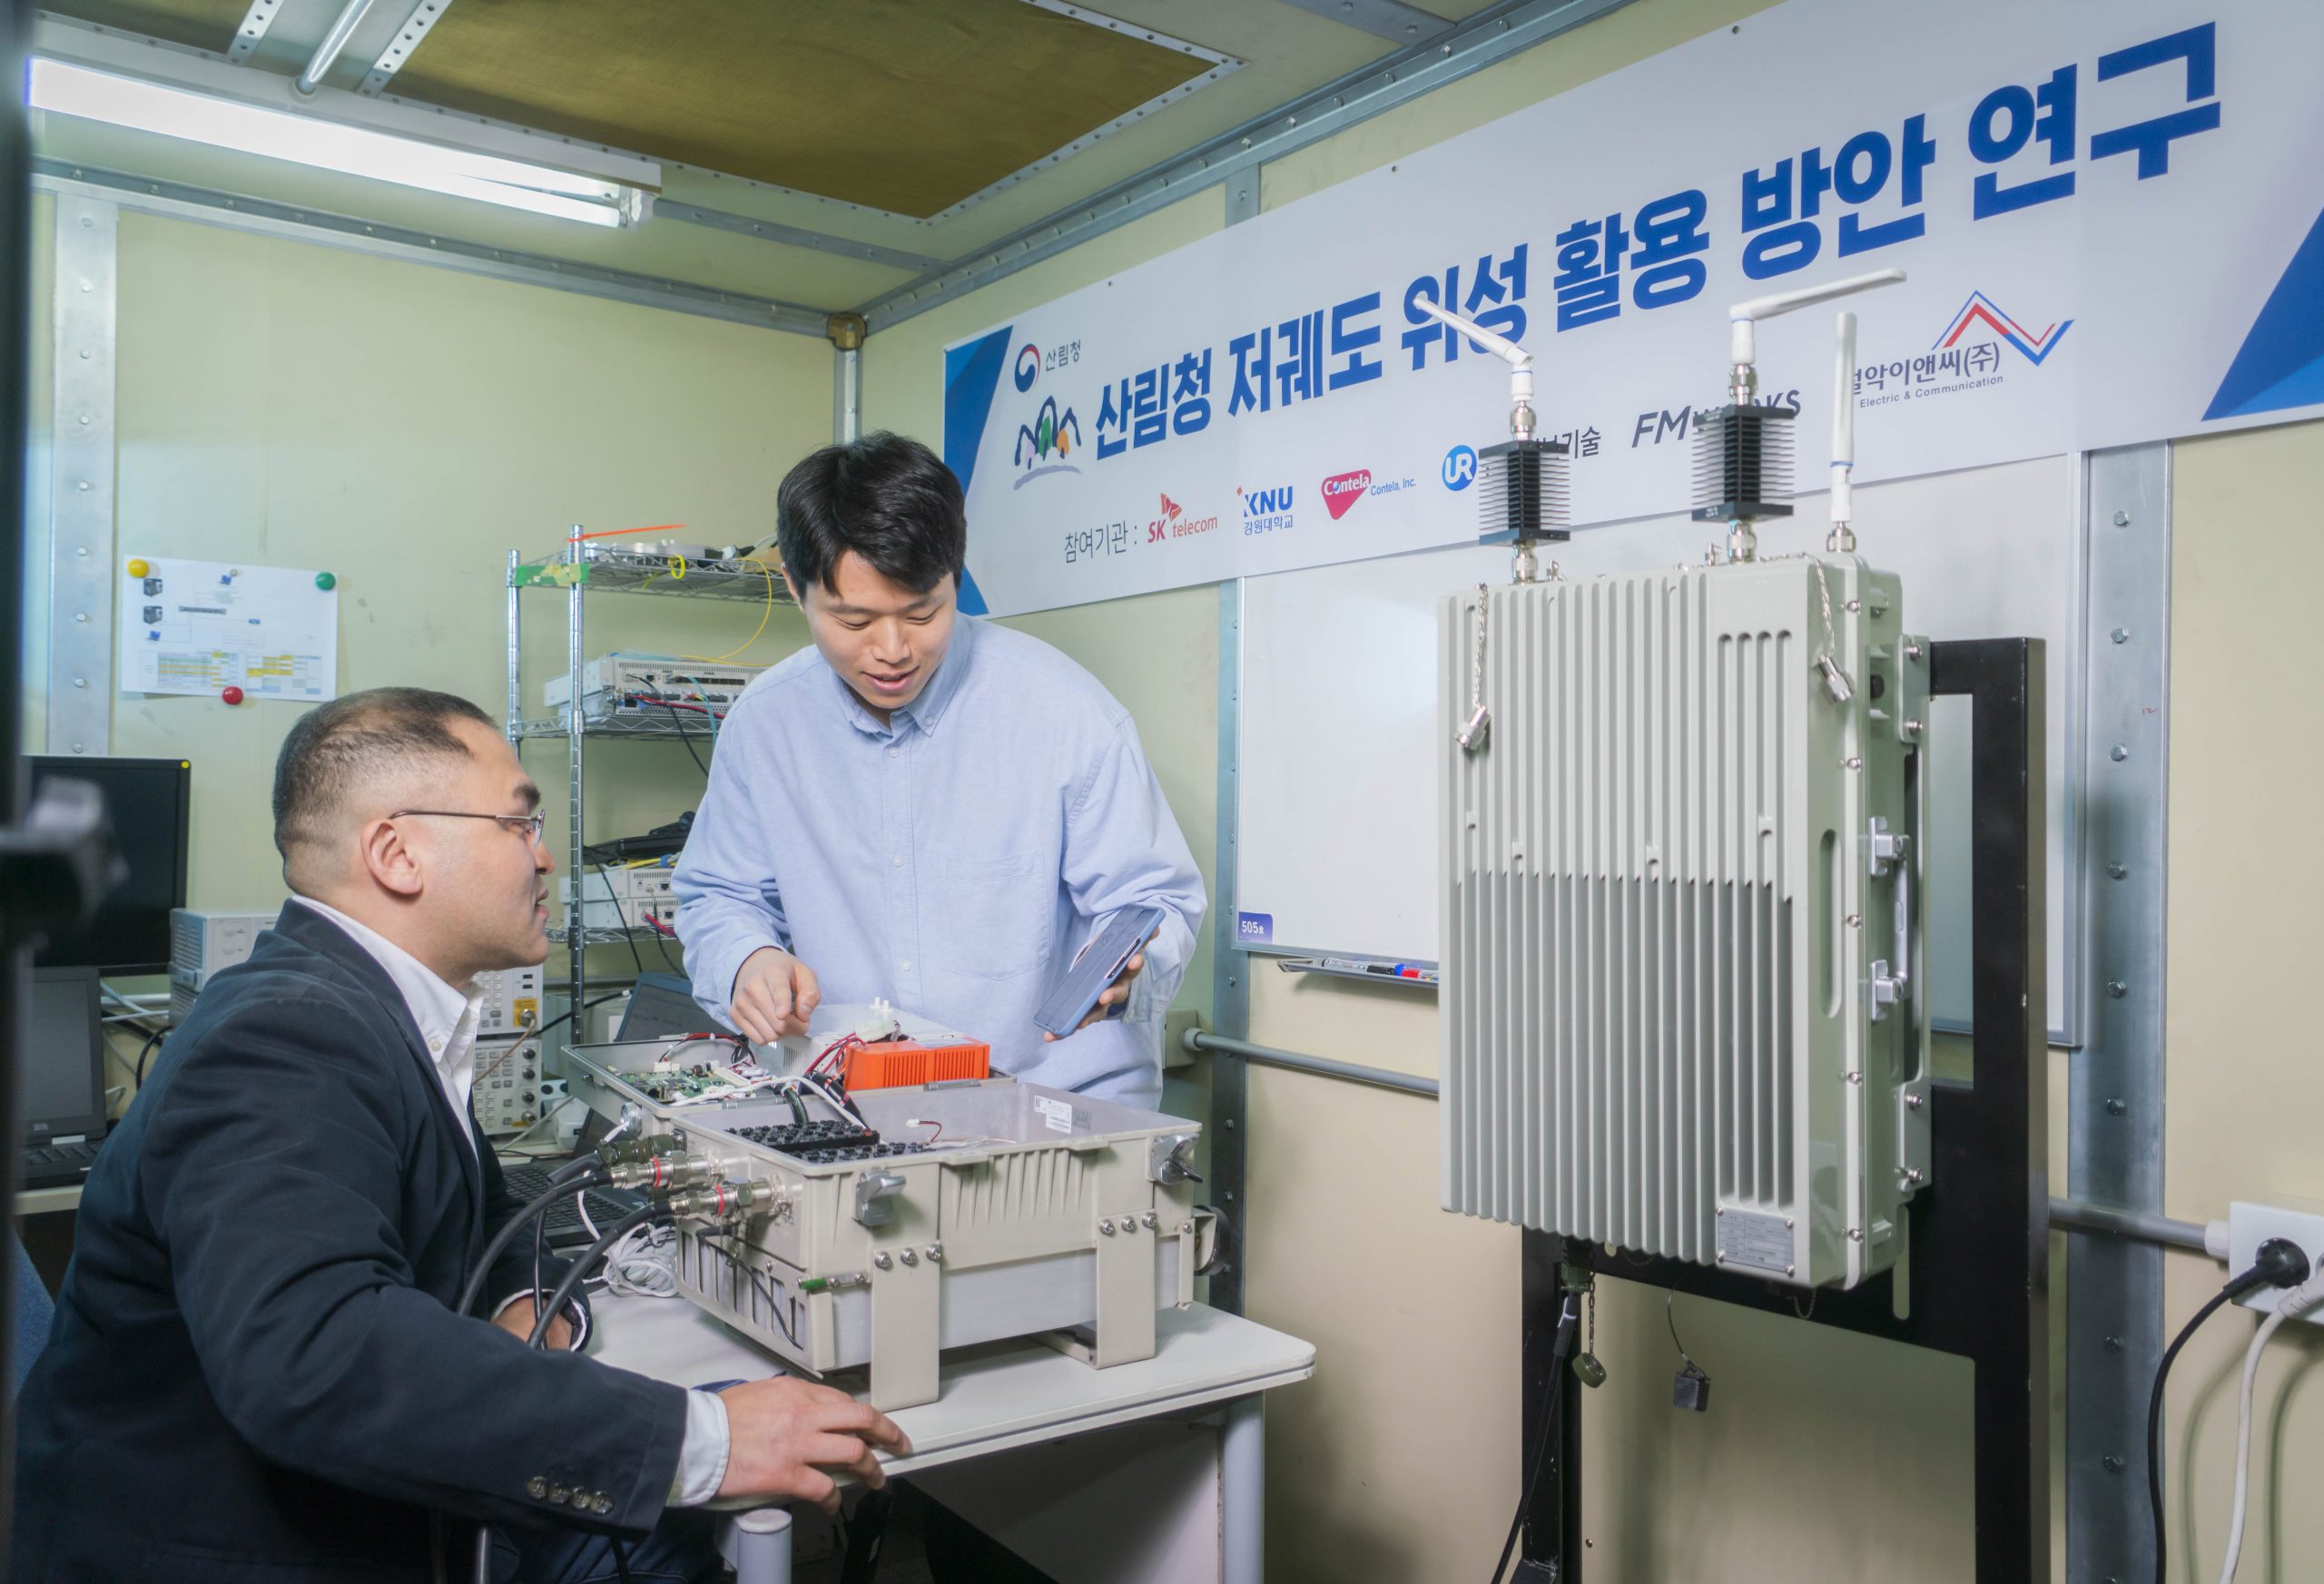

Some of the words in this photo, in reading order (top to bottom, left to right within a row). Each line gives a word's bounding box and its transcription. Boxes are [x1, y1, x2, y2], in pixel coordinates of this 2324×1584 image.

[1096, 347, 1212, 461] 산림청
[1227, 291, 1383, 418] 저궤도
[1401, 242, 1529, 371] 위성
[1553, 189, 1710, 333] 활용
[1741, 113, 1936, 280] 방안
[1968, 21, 2221, 221] 연구
[1046, 339, 1081, 372] 산림청
[1859, 393, 1900, 408] Electric
[1904, 390, 1911, 400] &
[1915, 375, 2004, 398] Communication
[1243, 485, 1294, 518] KNU
[1323, 473, 1371, 497] Contela
[1370, 480, 1402, 497] Contela,
[1403, 477, 1417, 488] Inc.
[1147, 518, 1167, 544] SK
[1171, 516, 1218, 539] telecom
[1243, 514, 1294, 536] 강원대학교
[1064, 520, 1128, 564] 참여기관
